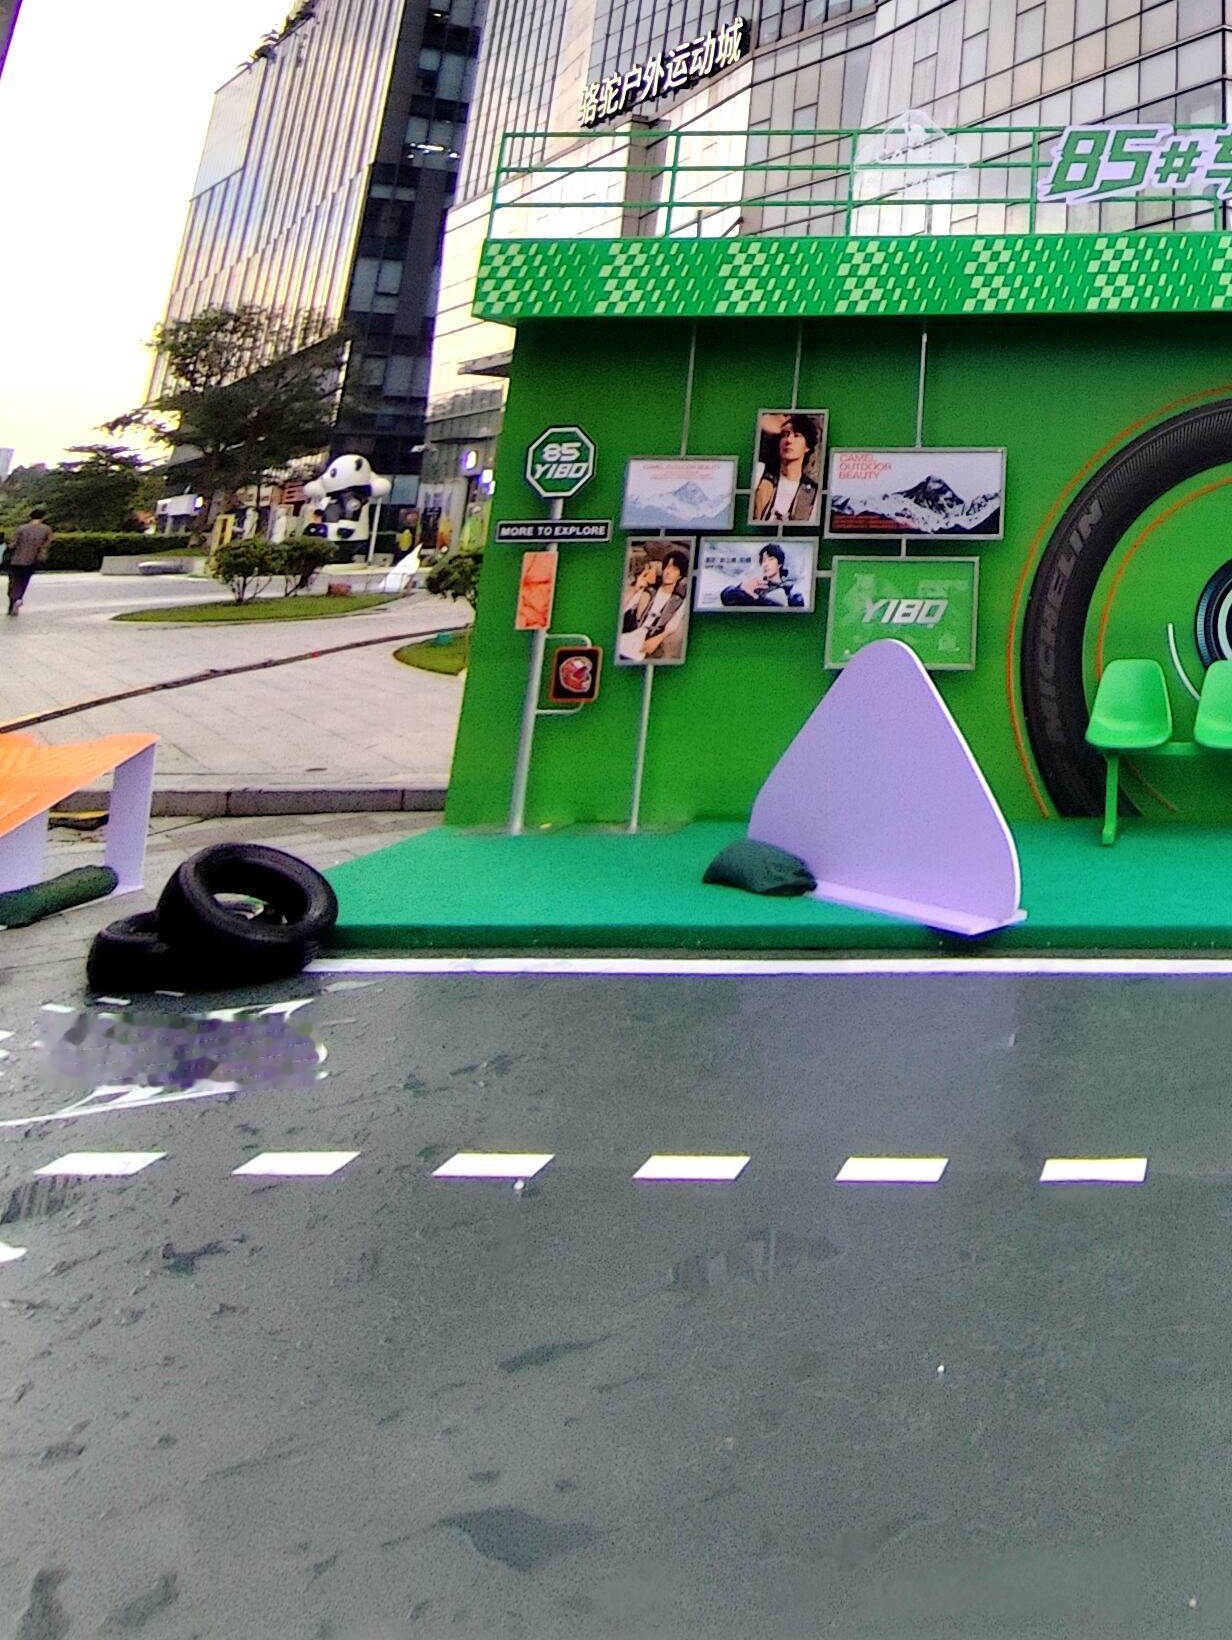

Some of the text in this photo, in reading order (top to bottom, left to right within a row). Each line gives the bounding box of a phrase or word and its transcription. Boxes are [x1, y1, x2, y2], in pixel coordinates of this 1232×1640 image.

[577, 15, 744, 128] 骆驼户外运动城
[542, 442, 582, 461] 85
[533, 462, 590, 480] YIBO
[839, 463, 892, 471] OUTDOOR
[500, 525, 606, 537] MORE TO EXPLORE
[862, 599, 949, 624] YIBO
[1038, 498, 1105, 743] MICHELIN
